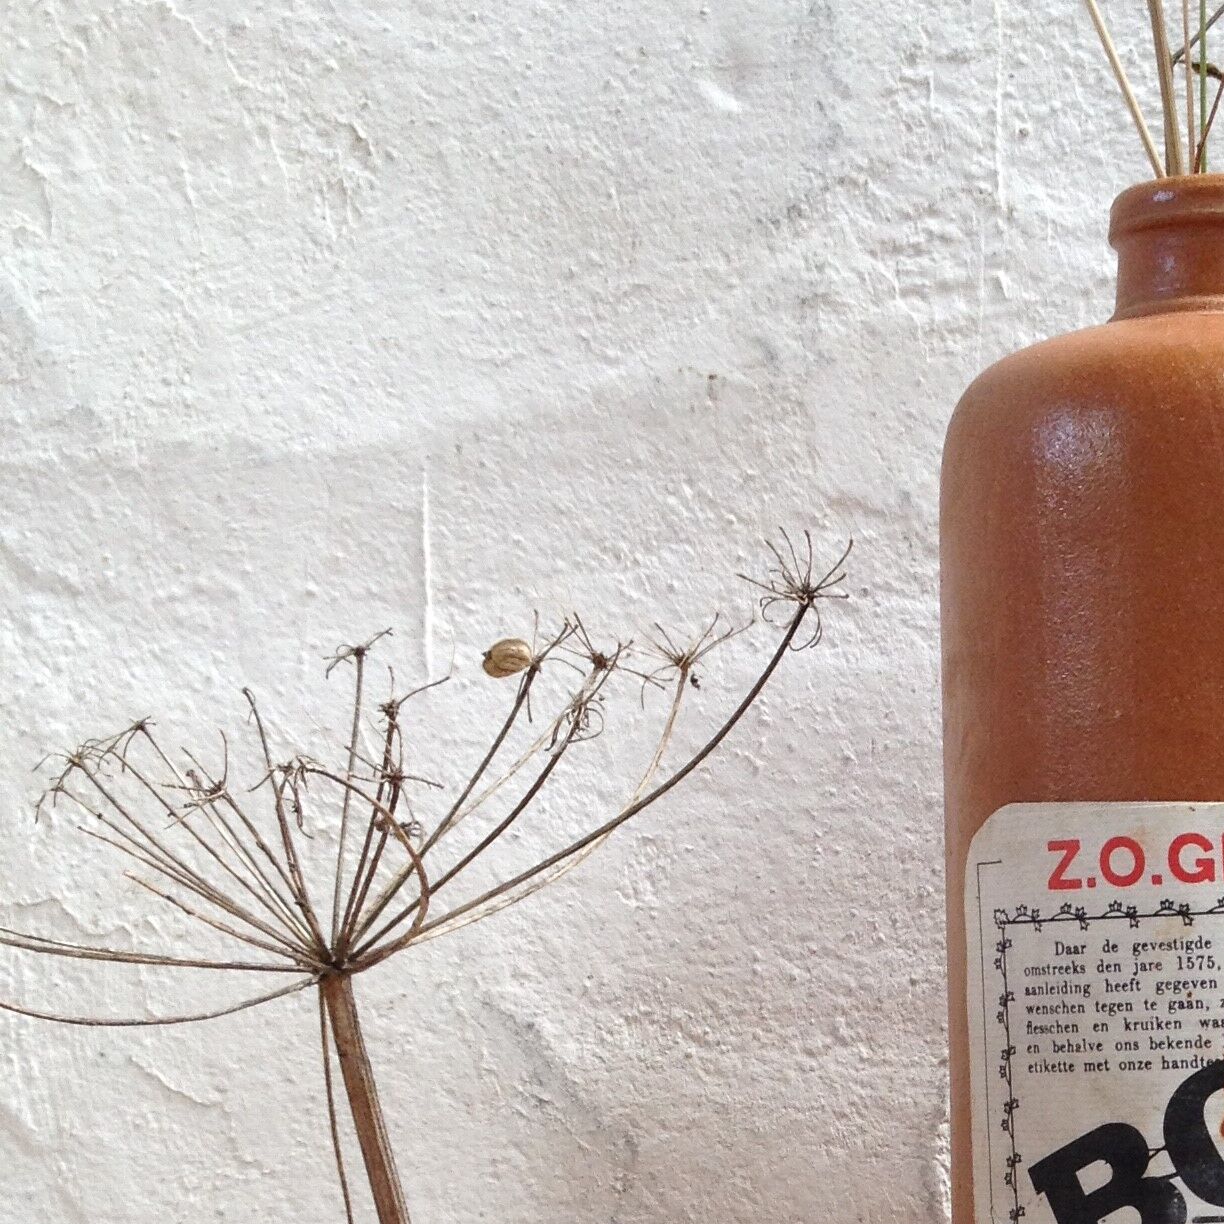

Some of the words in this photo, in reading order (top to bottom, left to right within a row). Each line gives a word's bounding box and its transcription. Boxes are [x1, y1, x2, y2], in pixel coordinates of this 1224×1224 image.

[1055, 941, 1087, 956] Daar
[1102, 939, 1119, 953] de
[1132, 938, 1212, 955] gevestigde
[1024, 961, 1086, 977] omstreeks
[1096, 960, 1121, 974] den
[1133, 958, 1163, 976] jare
[1177, 955, 1222, 971] 1575,
[1025, 980, 1091, 998] aanleiding
[1105, 978, 1142, 993] heeft
[1155, 979, 1218, 995] gegeven
[1026, 1000, 1085, 1015] wenschen
[1095, 1000, 1133, 1016] tegen
[1144, 999, 1157, 1011] te
[1168, 998, 1210, 1014] gaan,
[1026, 1020, 1079, 1035] flesschen
[1093, 1021, 1109, 1032] en
[1124, 1016, 1182, 1031] kruiken
[1027, 1043, 1040, 1054] en
[1052, 1037, 1103, 1053] behalve
[1115, 1040, 1139, 1051] ons
[1150, 1035, 1212, 1050] bekende
[1028, 1059, 1074, 1074] etikette
[1084, 1060, 1110, 1073] met
[1119, 1060, 1152, 1071] onze
